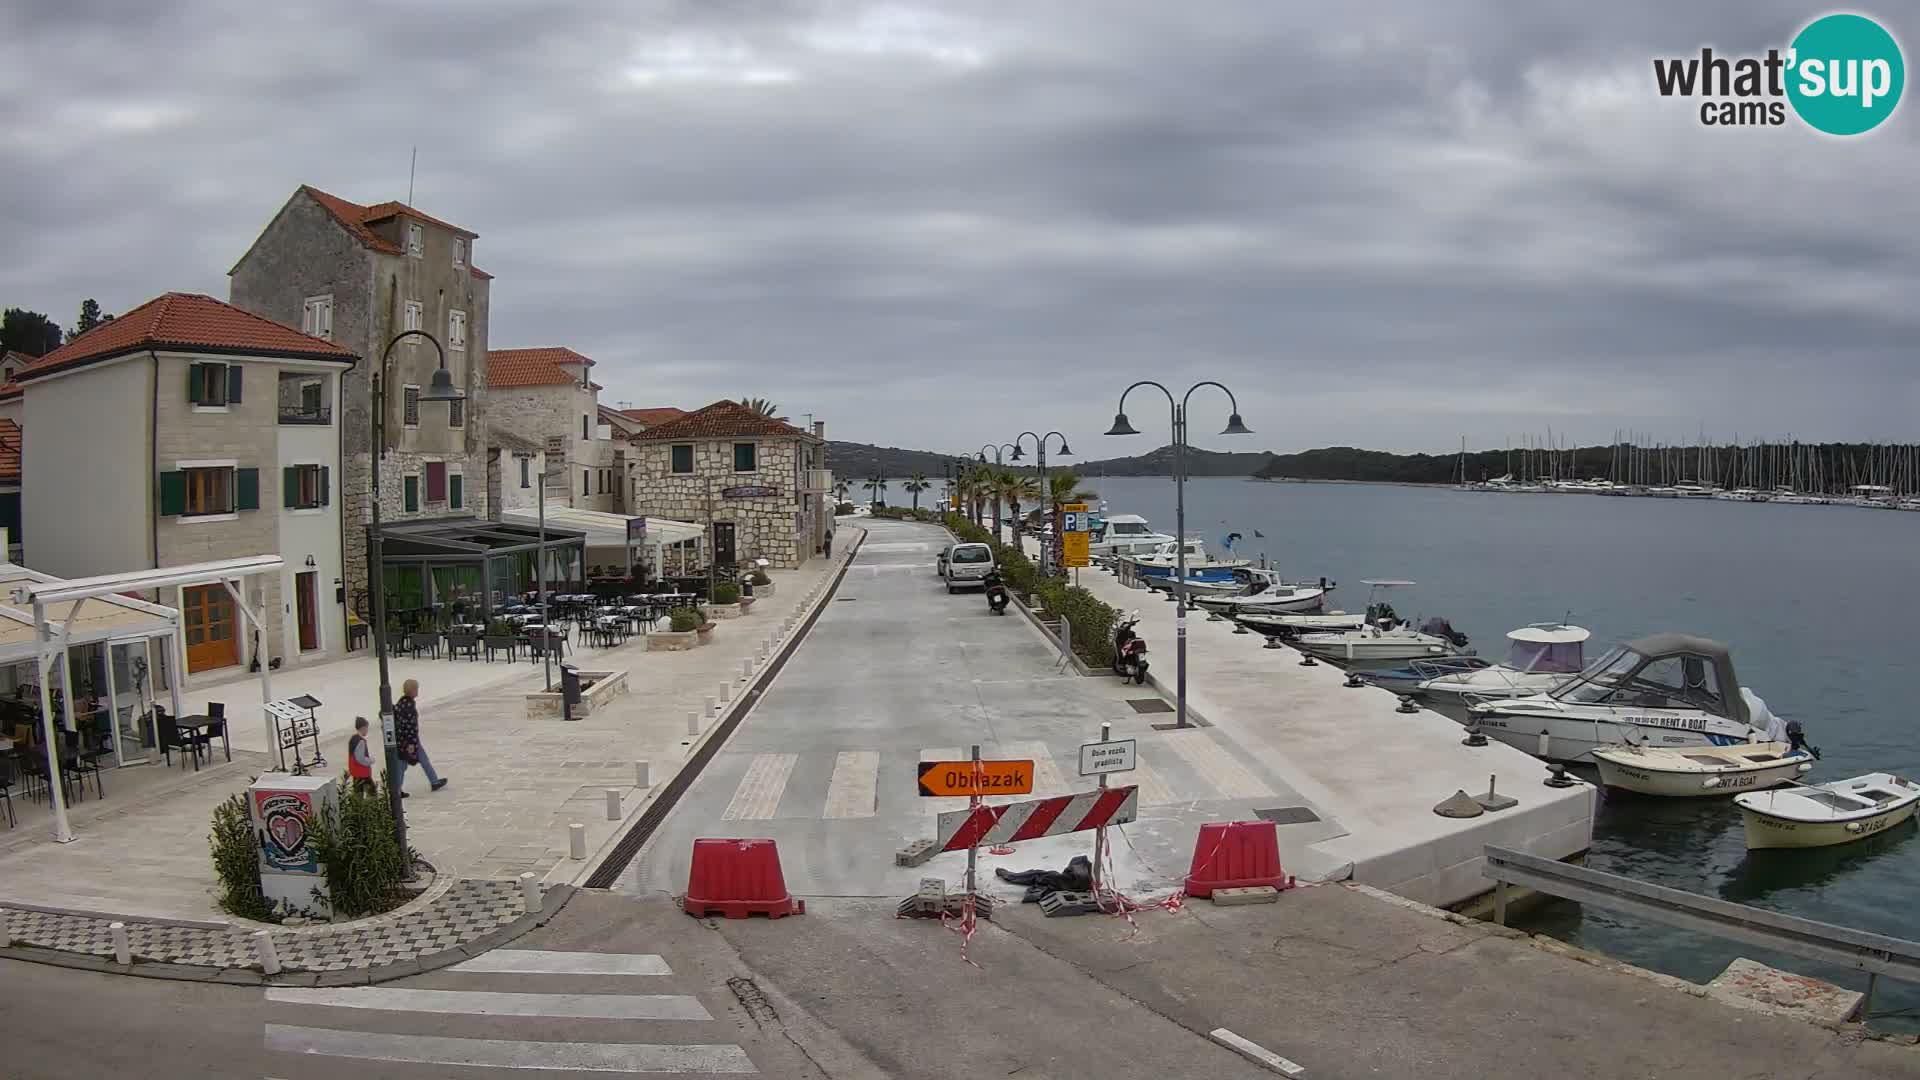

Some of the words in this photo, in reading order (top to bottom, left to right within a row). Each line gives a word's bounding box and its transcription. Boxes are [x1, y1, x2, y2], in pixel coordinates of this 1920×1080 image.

[1065, 514, 1076, 530] P
[1660, 718, 1681, 727] RENT
[1681, 719, 1687, 728] A
[1688, 719, 1708, 730] BOAT
[945, 770, 1024, 788] Obilazak
[1739, 775, 1757, 787] BOAT
